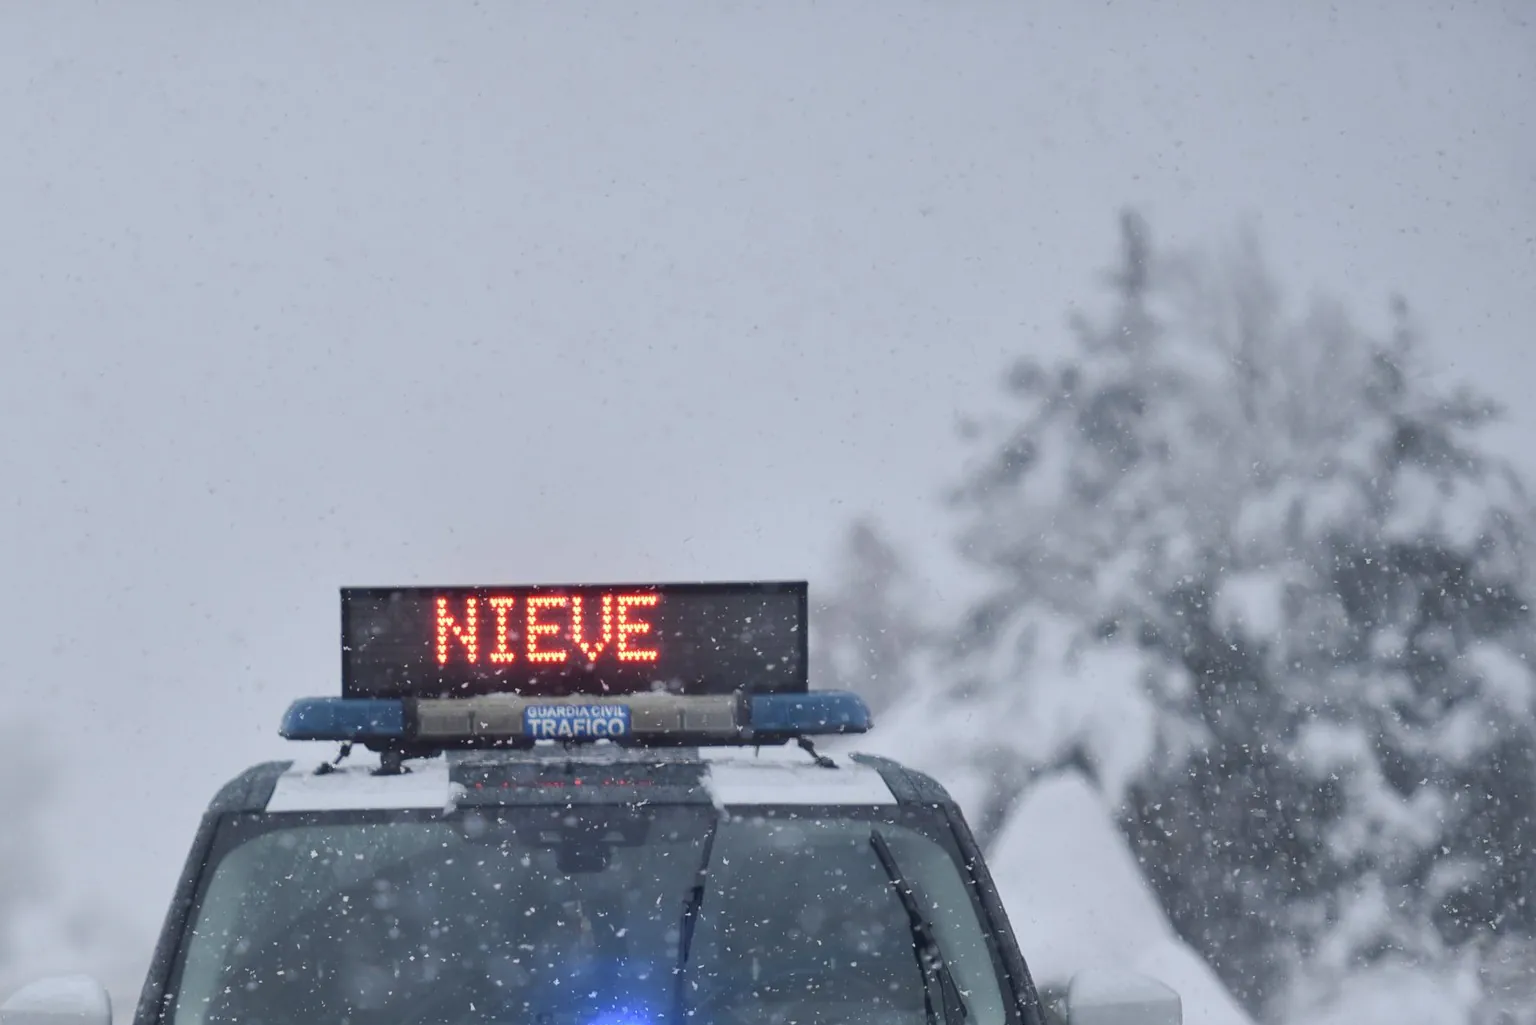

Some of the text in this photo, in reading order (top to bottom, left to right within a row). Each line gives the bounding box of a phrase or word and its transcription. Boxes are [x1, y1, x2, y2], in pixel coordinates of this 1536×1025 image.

[436, 594, 658, 664] NIEVE
[527, 704, 626, 718] GUARDIA CIVIL
[527, 718, 625, 736] TRAFICO
